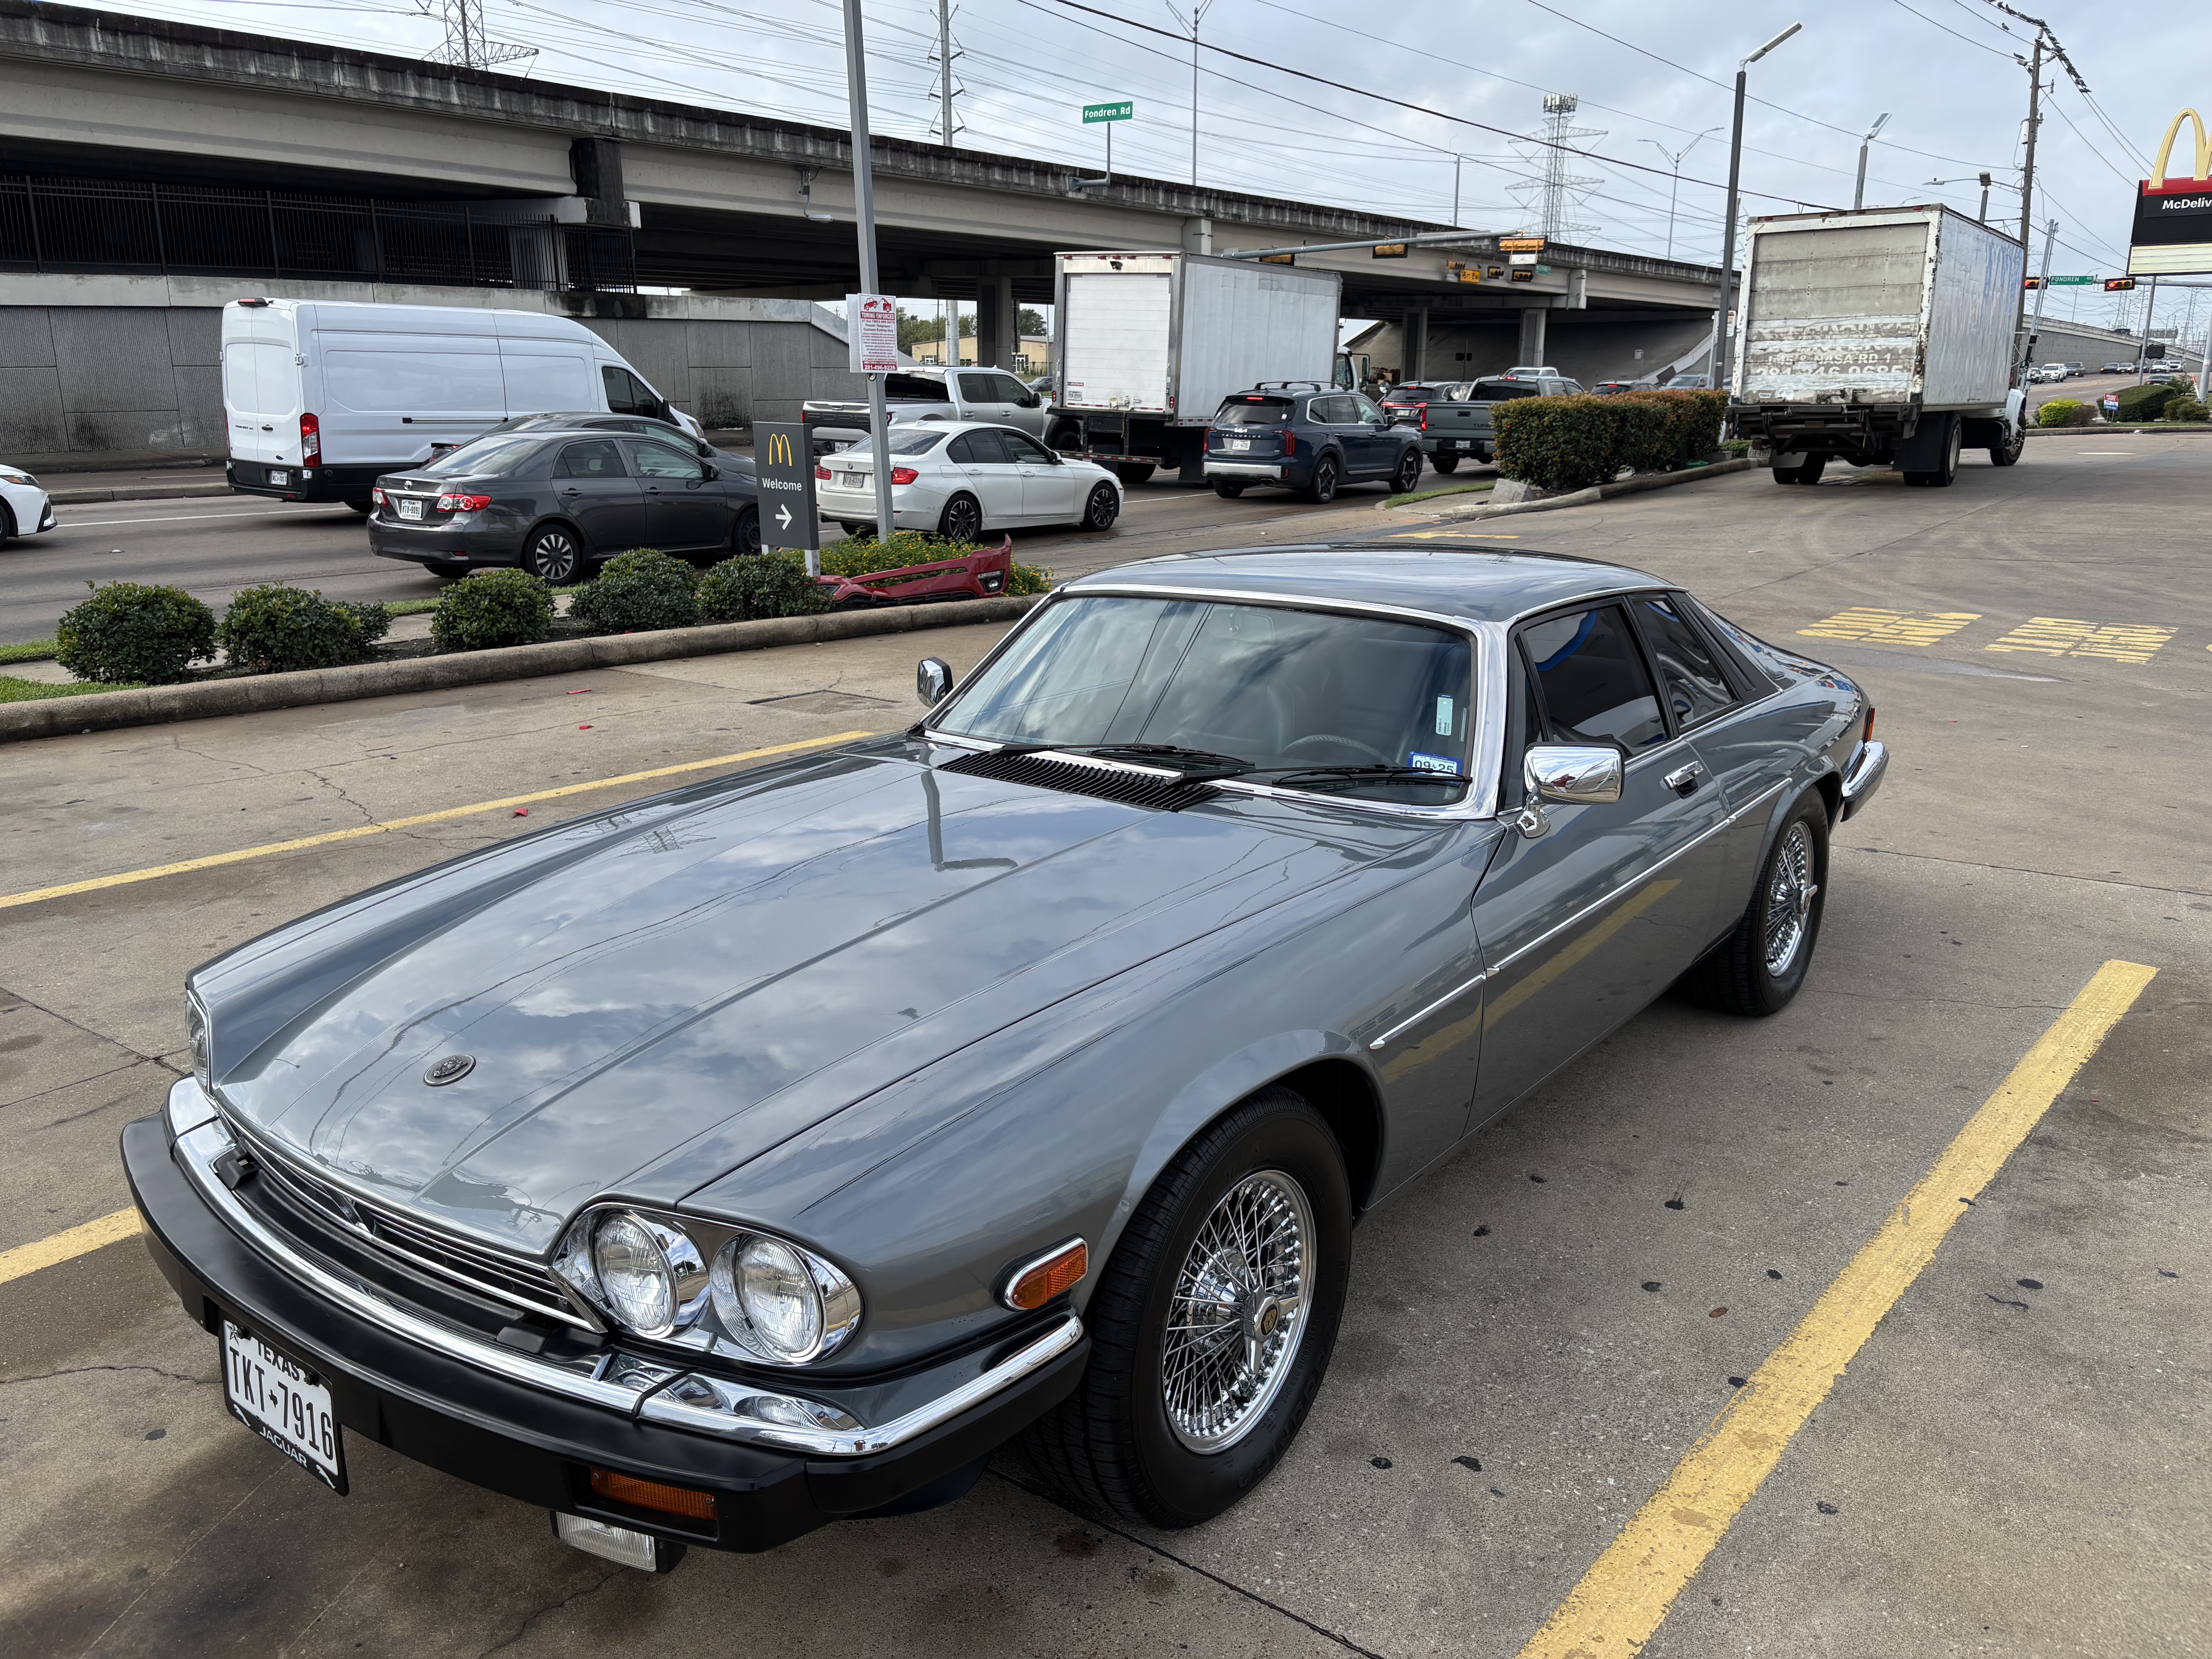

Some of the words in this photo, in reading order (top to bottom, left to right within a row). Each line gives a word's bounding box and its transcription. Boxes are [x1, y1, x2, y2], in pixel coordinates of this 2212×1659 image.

[1085, 108, 1116, 118] Fondren
[1120, 106, 1130, 115] Rd
[2162, 197, 2212, 210] McDeliv
[1858, 353, 1878, 364] RD
[1884, 353, 1891, 363] 1
[762, 478, 802, 491] Welcome
[256, 1339, 300, 1381] TEXAS
[259, 1426, 307, 1468] JAGUAR
